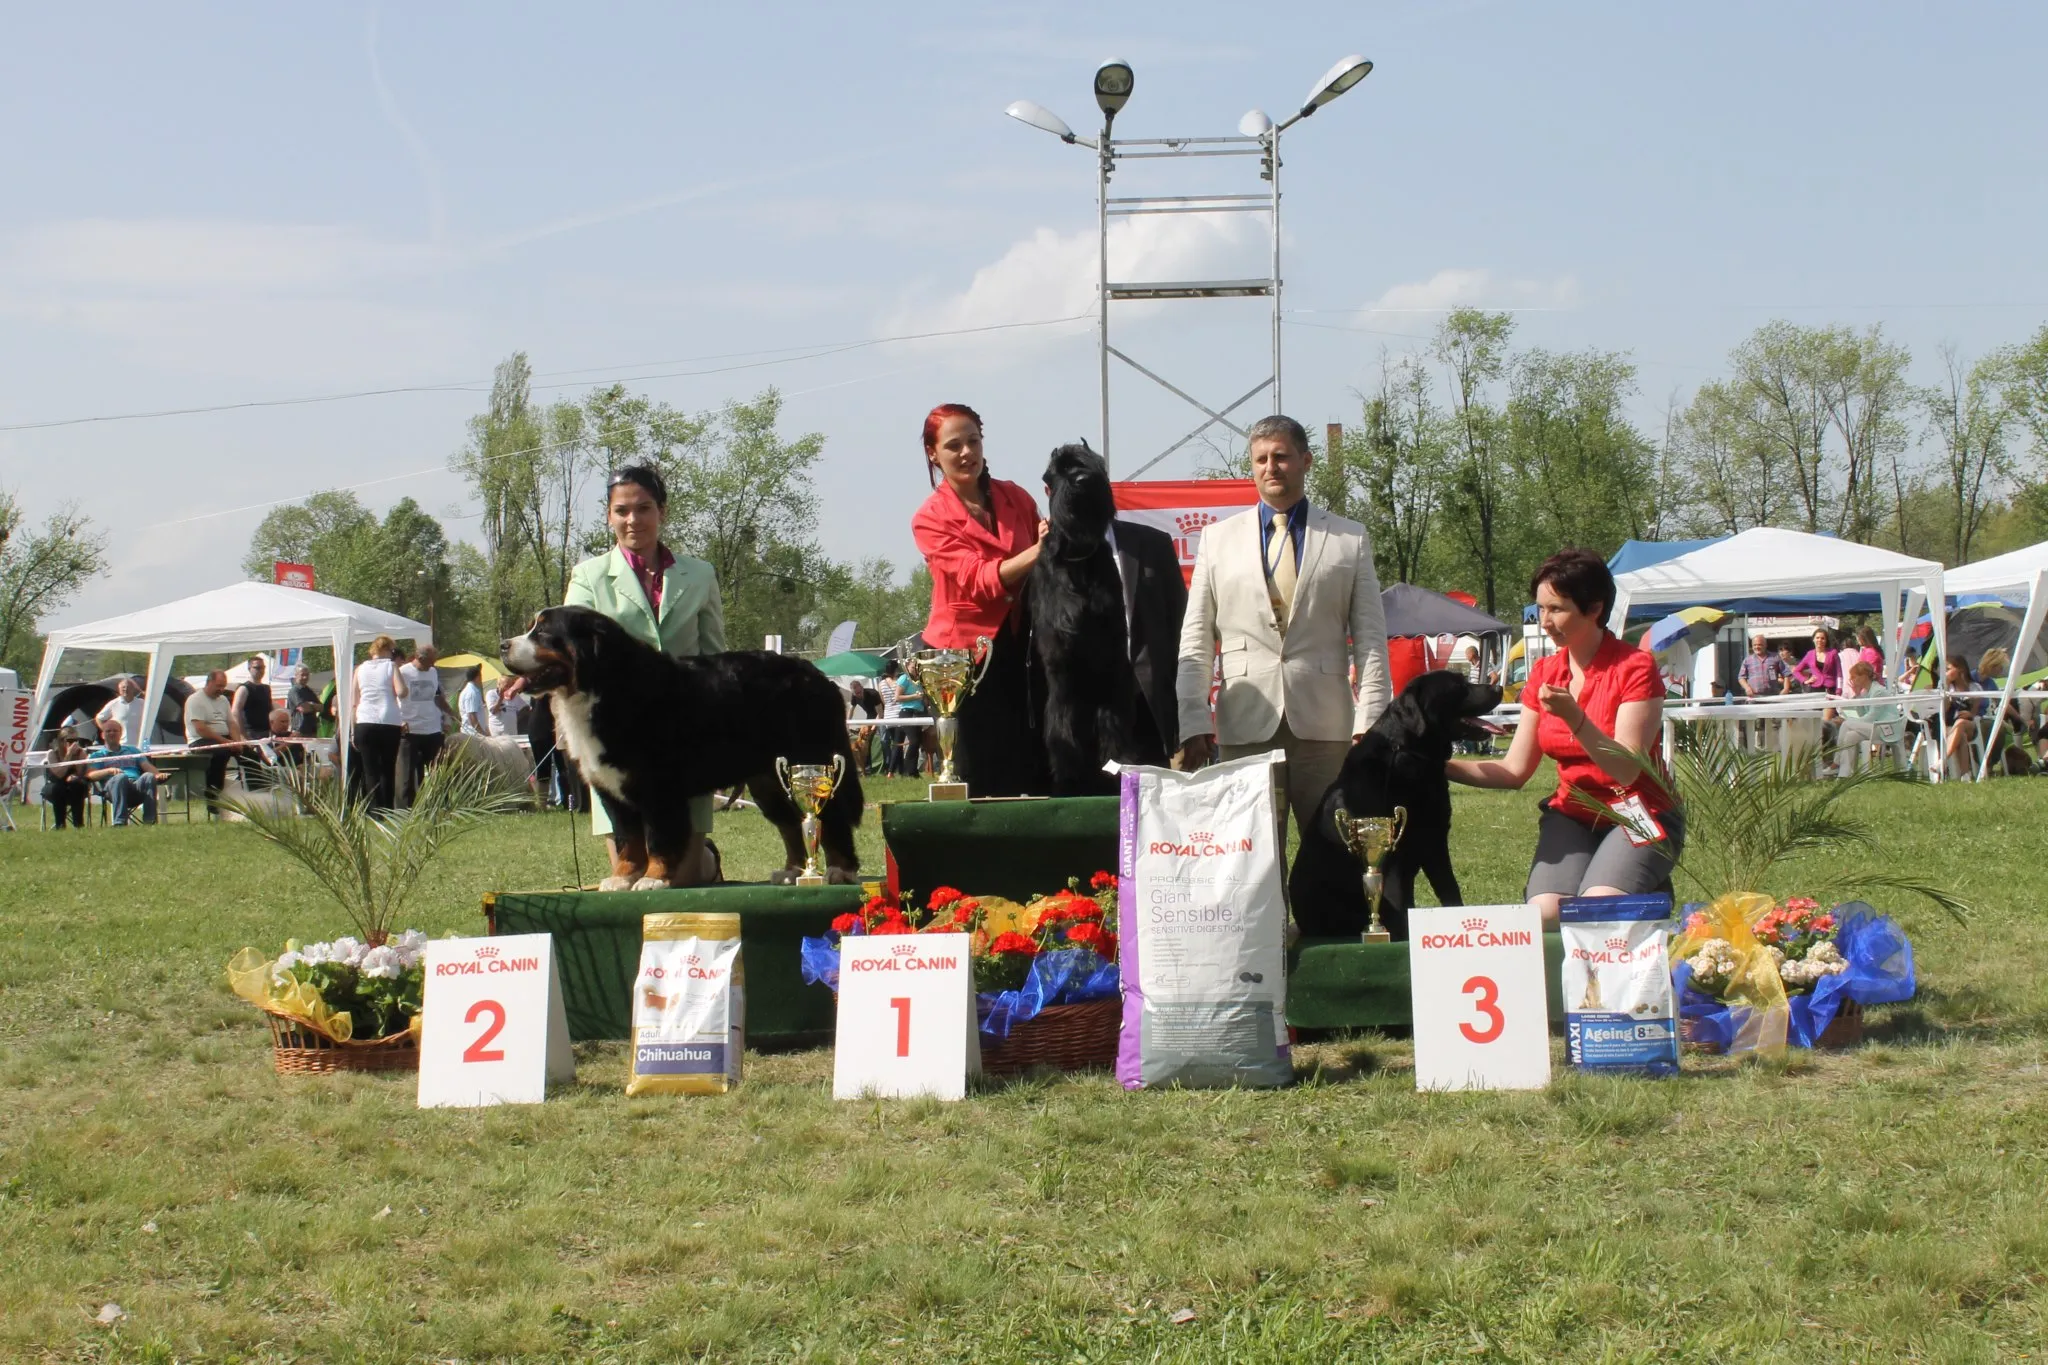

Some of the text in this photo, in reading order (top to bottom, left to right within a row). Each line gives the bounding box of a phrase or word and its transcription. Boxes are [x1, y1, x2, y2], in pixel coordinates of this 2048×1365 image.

[11, 697, 30, 754] CANIN
[1124, 838, 1133, 878] GIANT
[1150, 842, 1200, 857] ROYAL
[1149, 875, 1240, 884] PROFESSIOAL
[1151, 889, 1192, 904] Giant
[1151, 904, 1232, 923] Sensible
[1151, 925, 1244, 934] SENSITIVE DIGESTION
[1421, 931, 1531, 949] ROYAL CANIN
[851, 957, 957, 972] ROYAL CANIN
[1571, 948, 1614, 963] ROYAL
[436, 957, 538, 976] ROYAL CANIN
[1459, 976, 1505, 1044] 3
[463, 1000, 506, 1063] 2
[890, 997, 911, 1057] 1
[1584, 1027, 1633, 1042] Ageing
[1569, 1022, 1582, 1064] MAXI
[637, 1048, 712, 1062] Chihuahua
